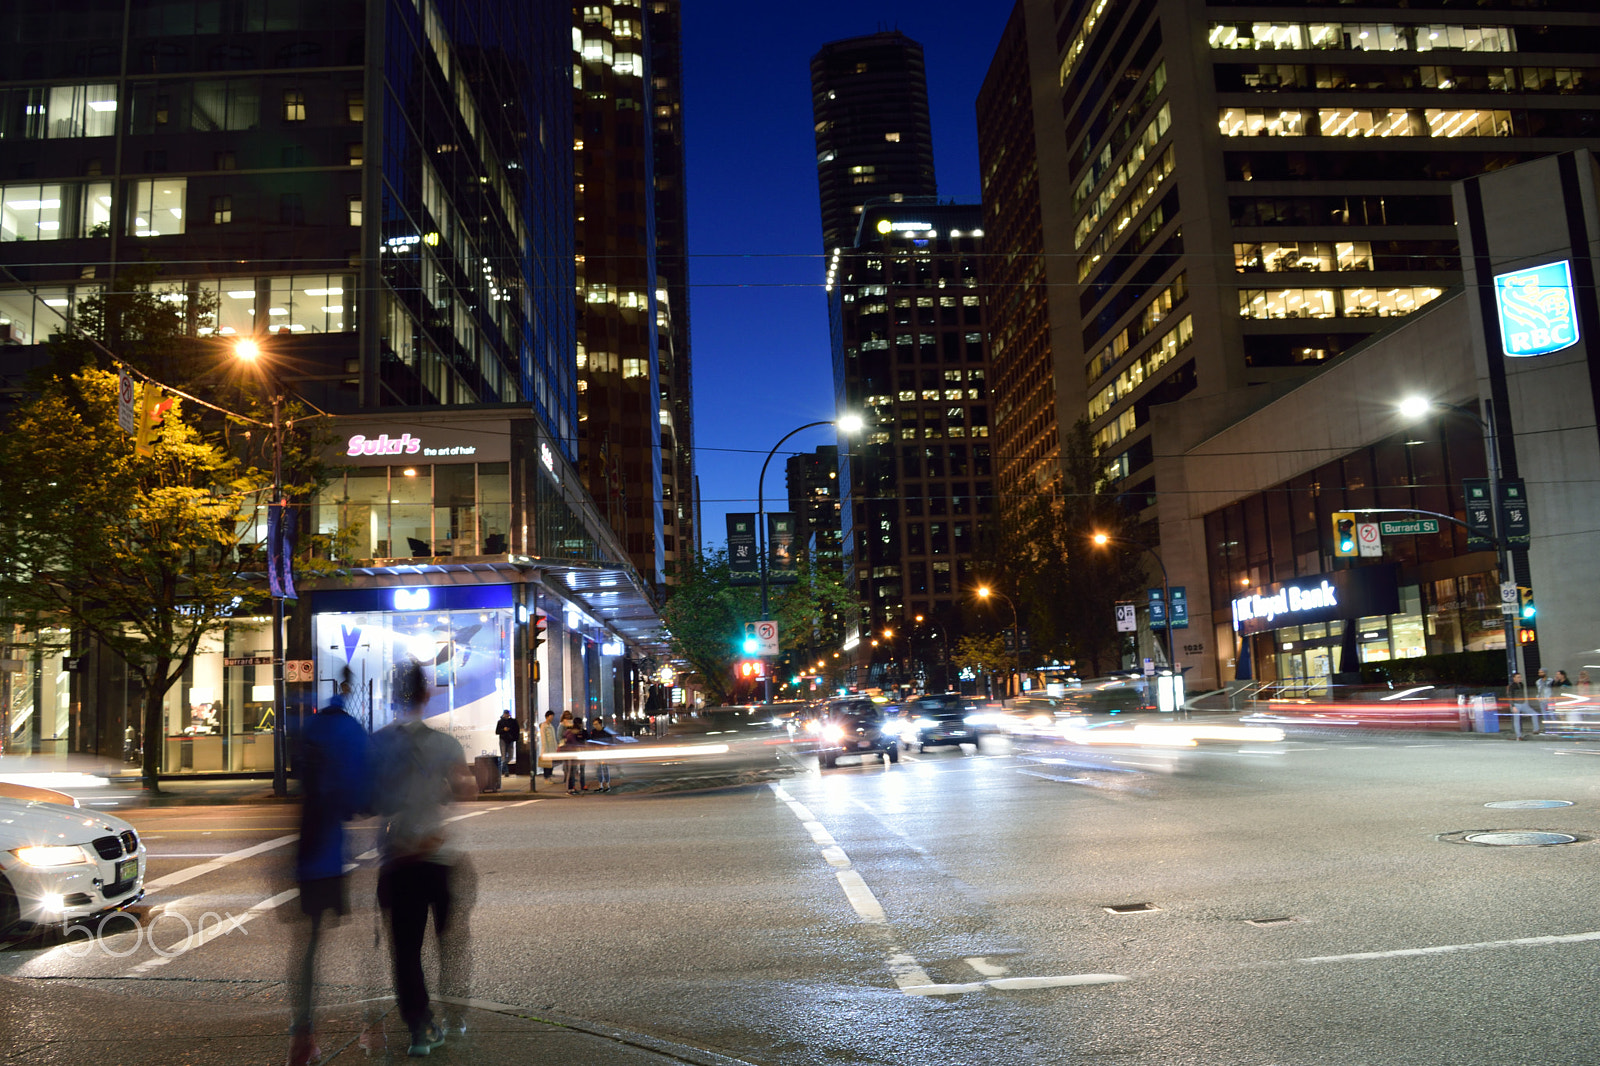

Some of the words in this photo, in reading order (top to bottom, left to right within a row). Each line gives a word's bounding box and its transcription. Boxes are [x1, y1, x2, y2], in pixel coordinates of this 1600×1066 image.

[1511, 324, 1571, 352] RBC
[347, 433, 421, 456] Suki's
[423, 447, 437, 456] the
[438, 447, 450, 456] art
[450, 446, 460, 456] of
[459, 445, 477, 455] hair
[1384, 523, 1420, 533] Burrard
[1423, 522, 1435, 531] St
[1288, 580, 1337, 612] Bank
[1503, 589, 1515, 598] 99
[1184, 644, 1203, 652] 1025
[225, 658, 254, 666] Burrard
